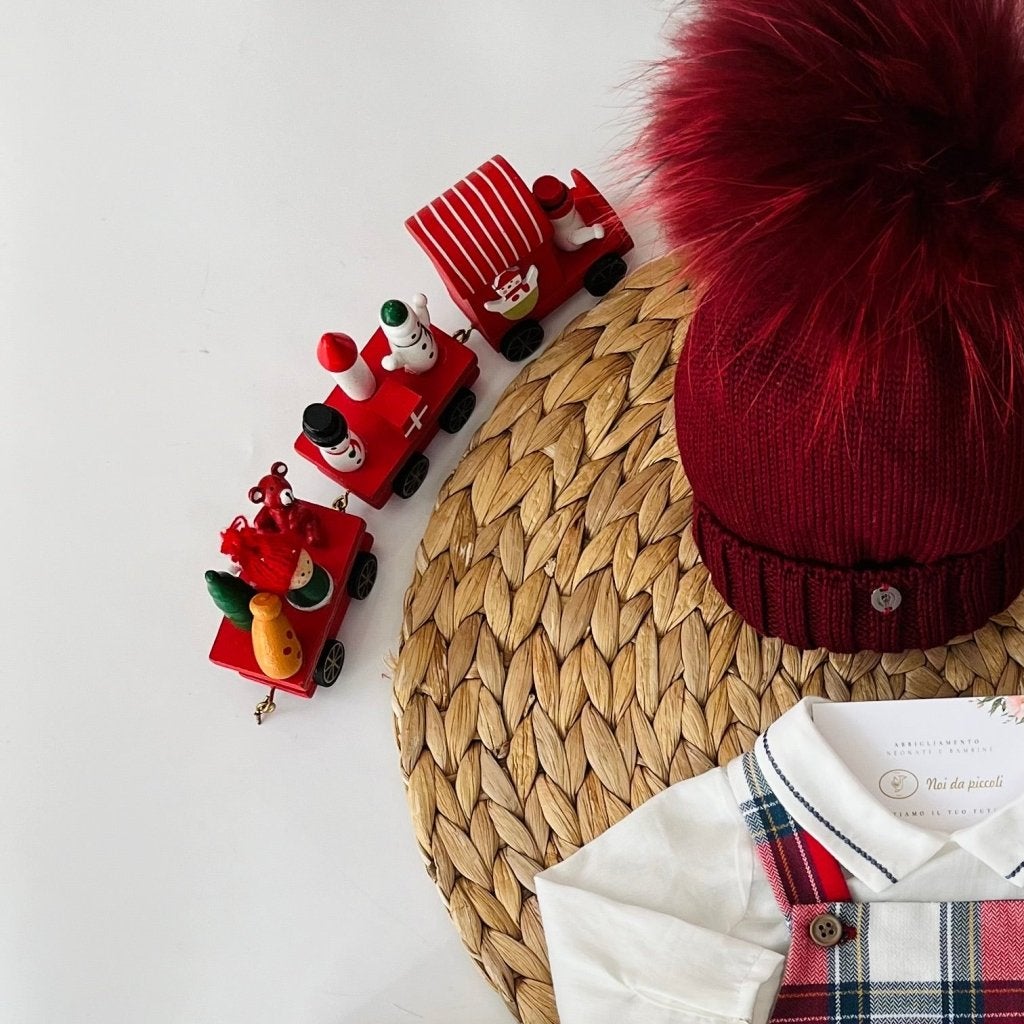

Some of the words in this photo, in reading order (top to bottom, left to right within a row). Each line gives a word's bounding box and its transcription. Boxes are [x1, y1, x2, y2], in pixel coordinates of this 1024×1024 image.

[926, 777, 948, 790] Noi
[950, 777, 965, 789] da
[967, 775, 1004, 792] piccoli
